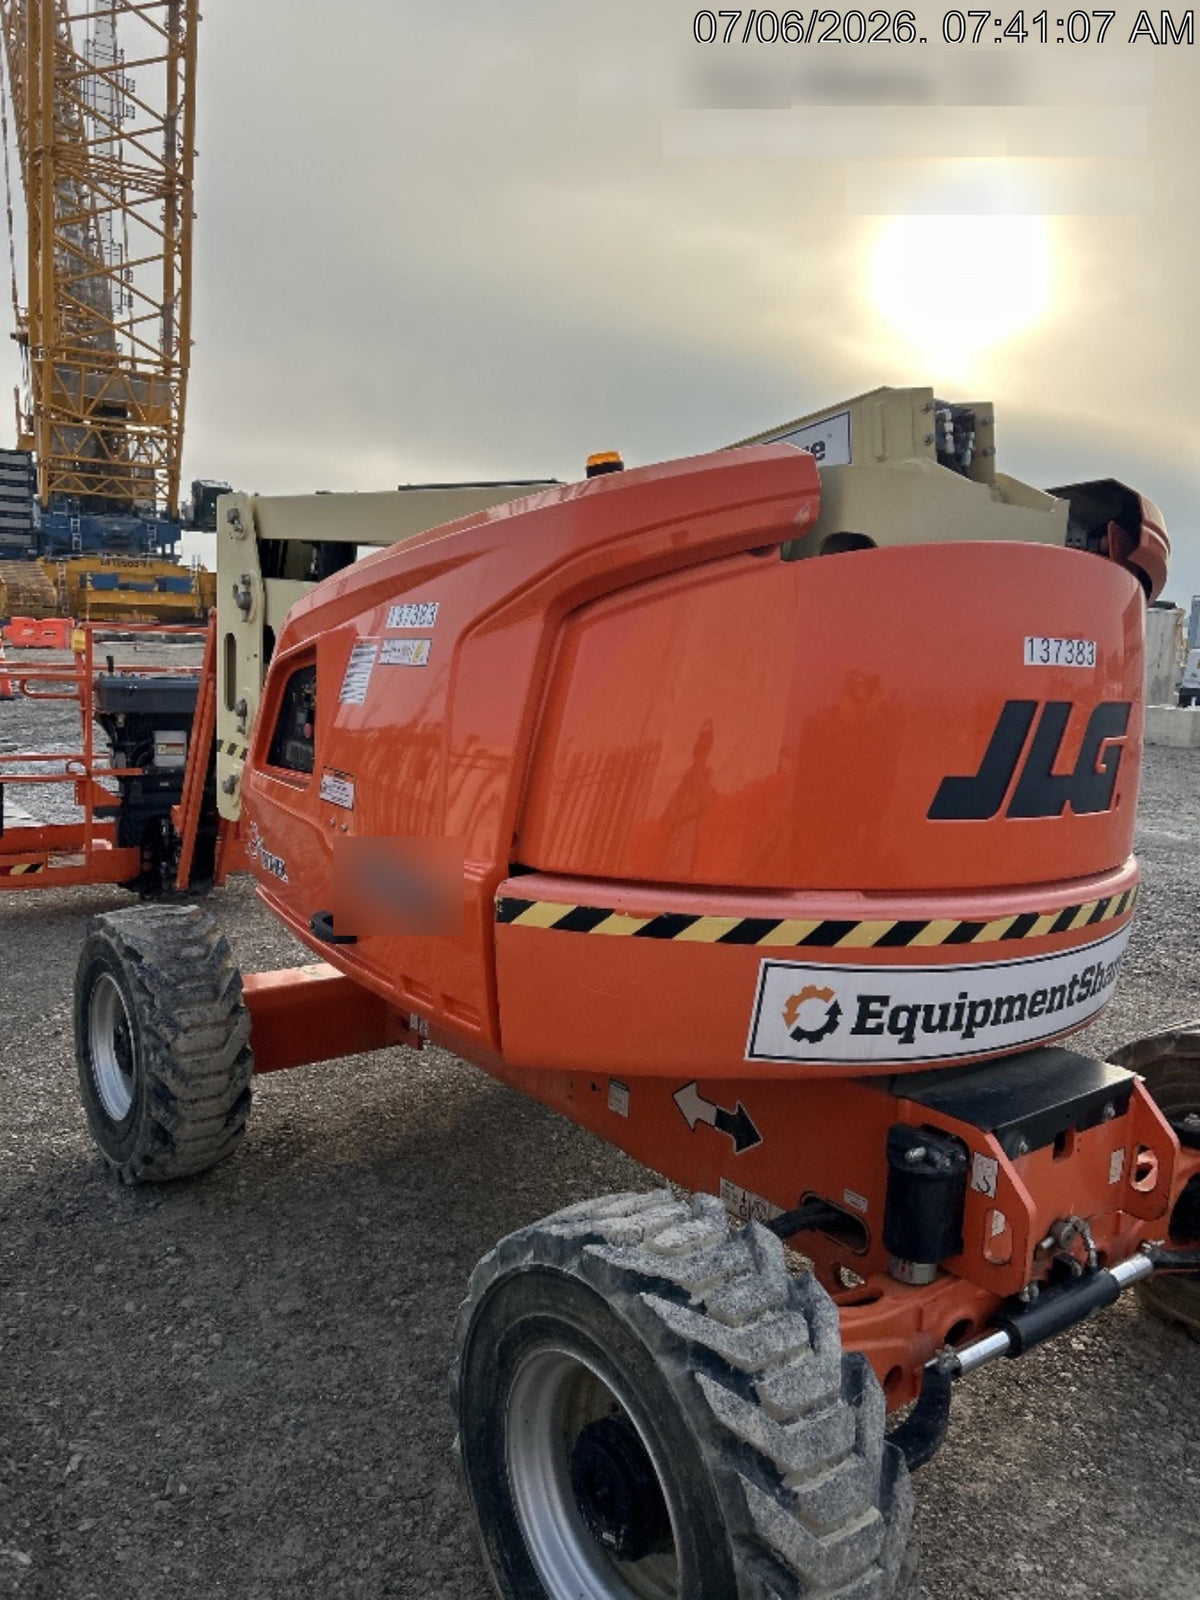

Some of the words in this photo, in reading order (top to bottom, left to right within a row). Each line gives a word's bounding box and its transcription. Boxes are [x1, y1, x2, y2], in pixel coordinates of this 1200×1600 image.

[1027, 637, 1095, 665] 137383
[927, 700, 1132, 819] JLG
[850, 954, 1122, 1044] EquipmentShar
